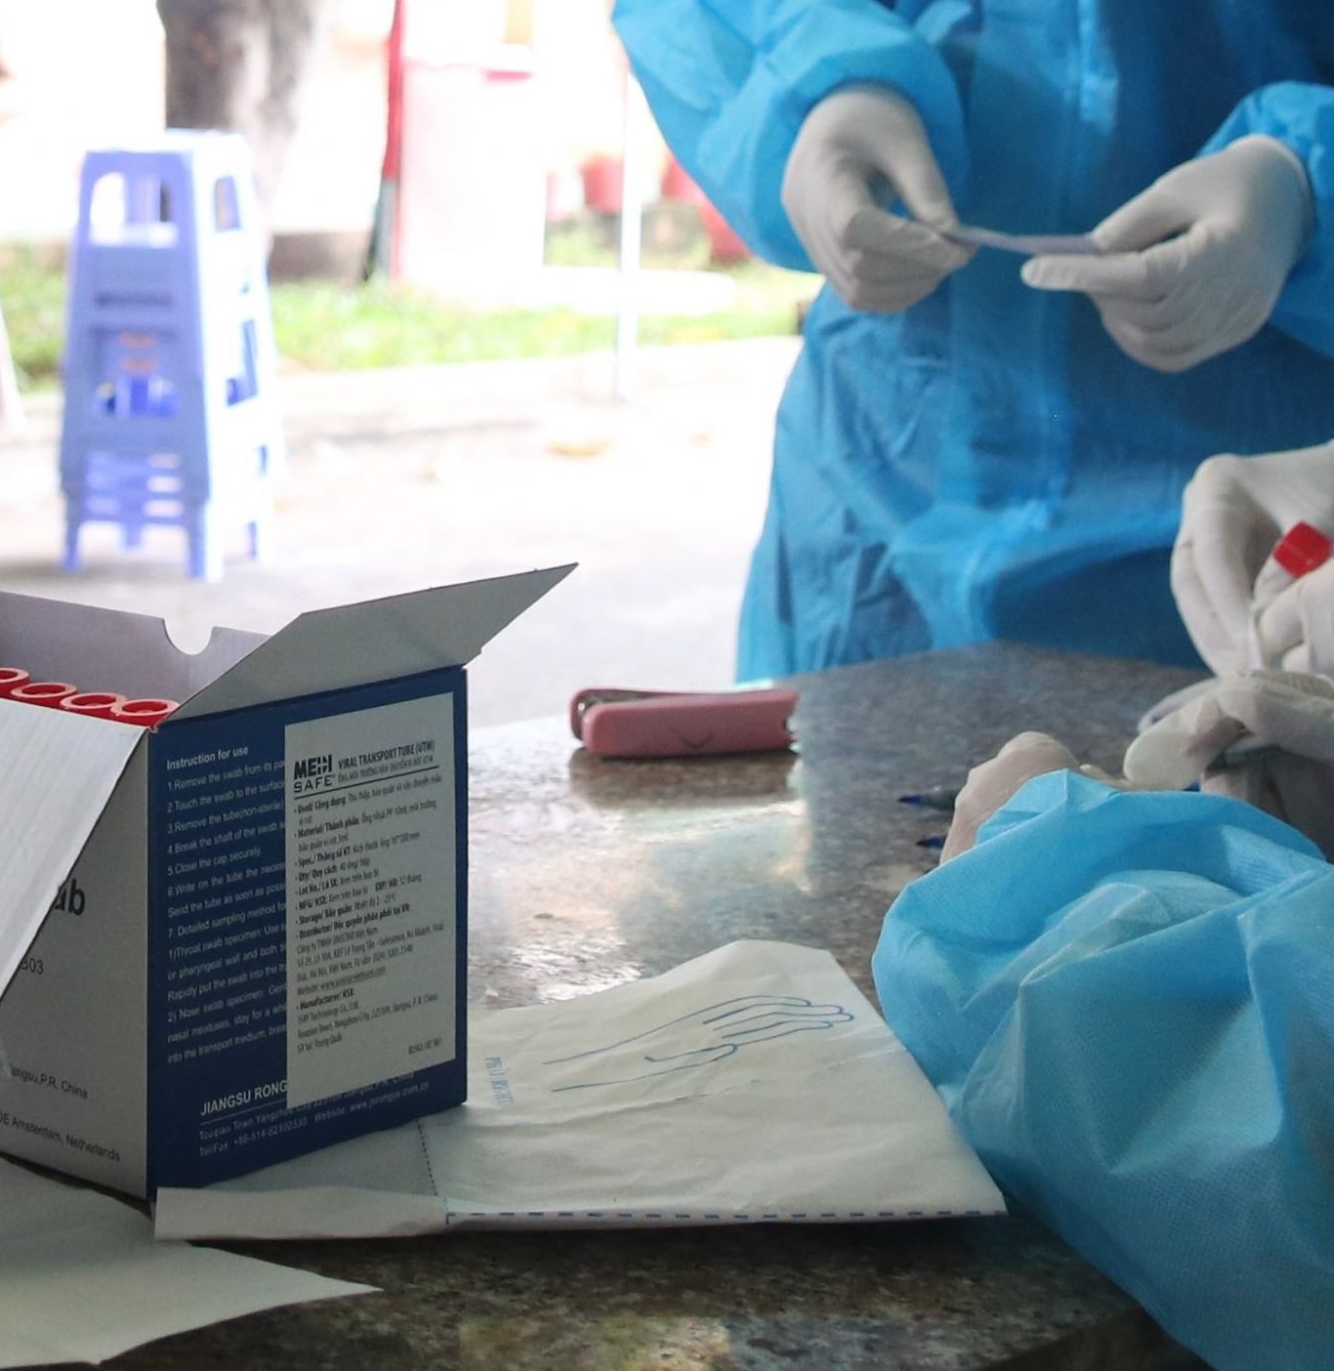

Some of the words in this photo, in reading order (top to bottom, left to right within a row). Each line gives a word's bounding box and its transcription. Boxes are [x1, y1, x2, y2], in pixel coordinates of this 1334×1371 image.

[167, 750, 215, 771] Instruction
[218, 748, 229, 759] for
[233, 746, 248, 757] use
[339, 756, 357, 769] VIRAL
[294, 774, 332, 793] SAFE
[61, 1079, 88, 1099] China
[201, 1090, 250, 1116] JIANGSU
